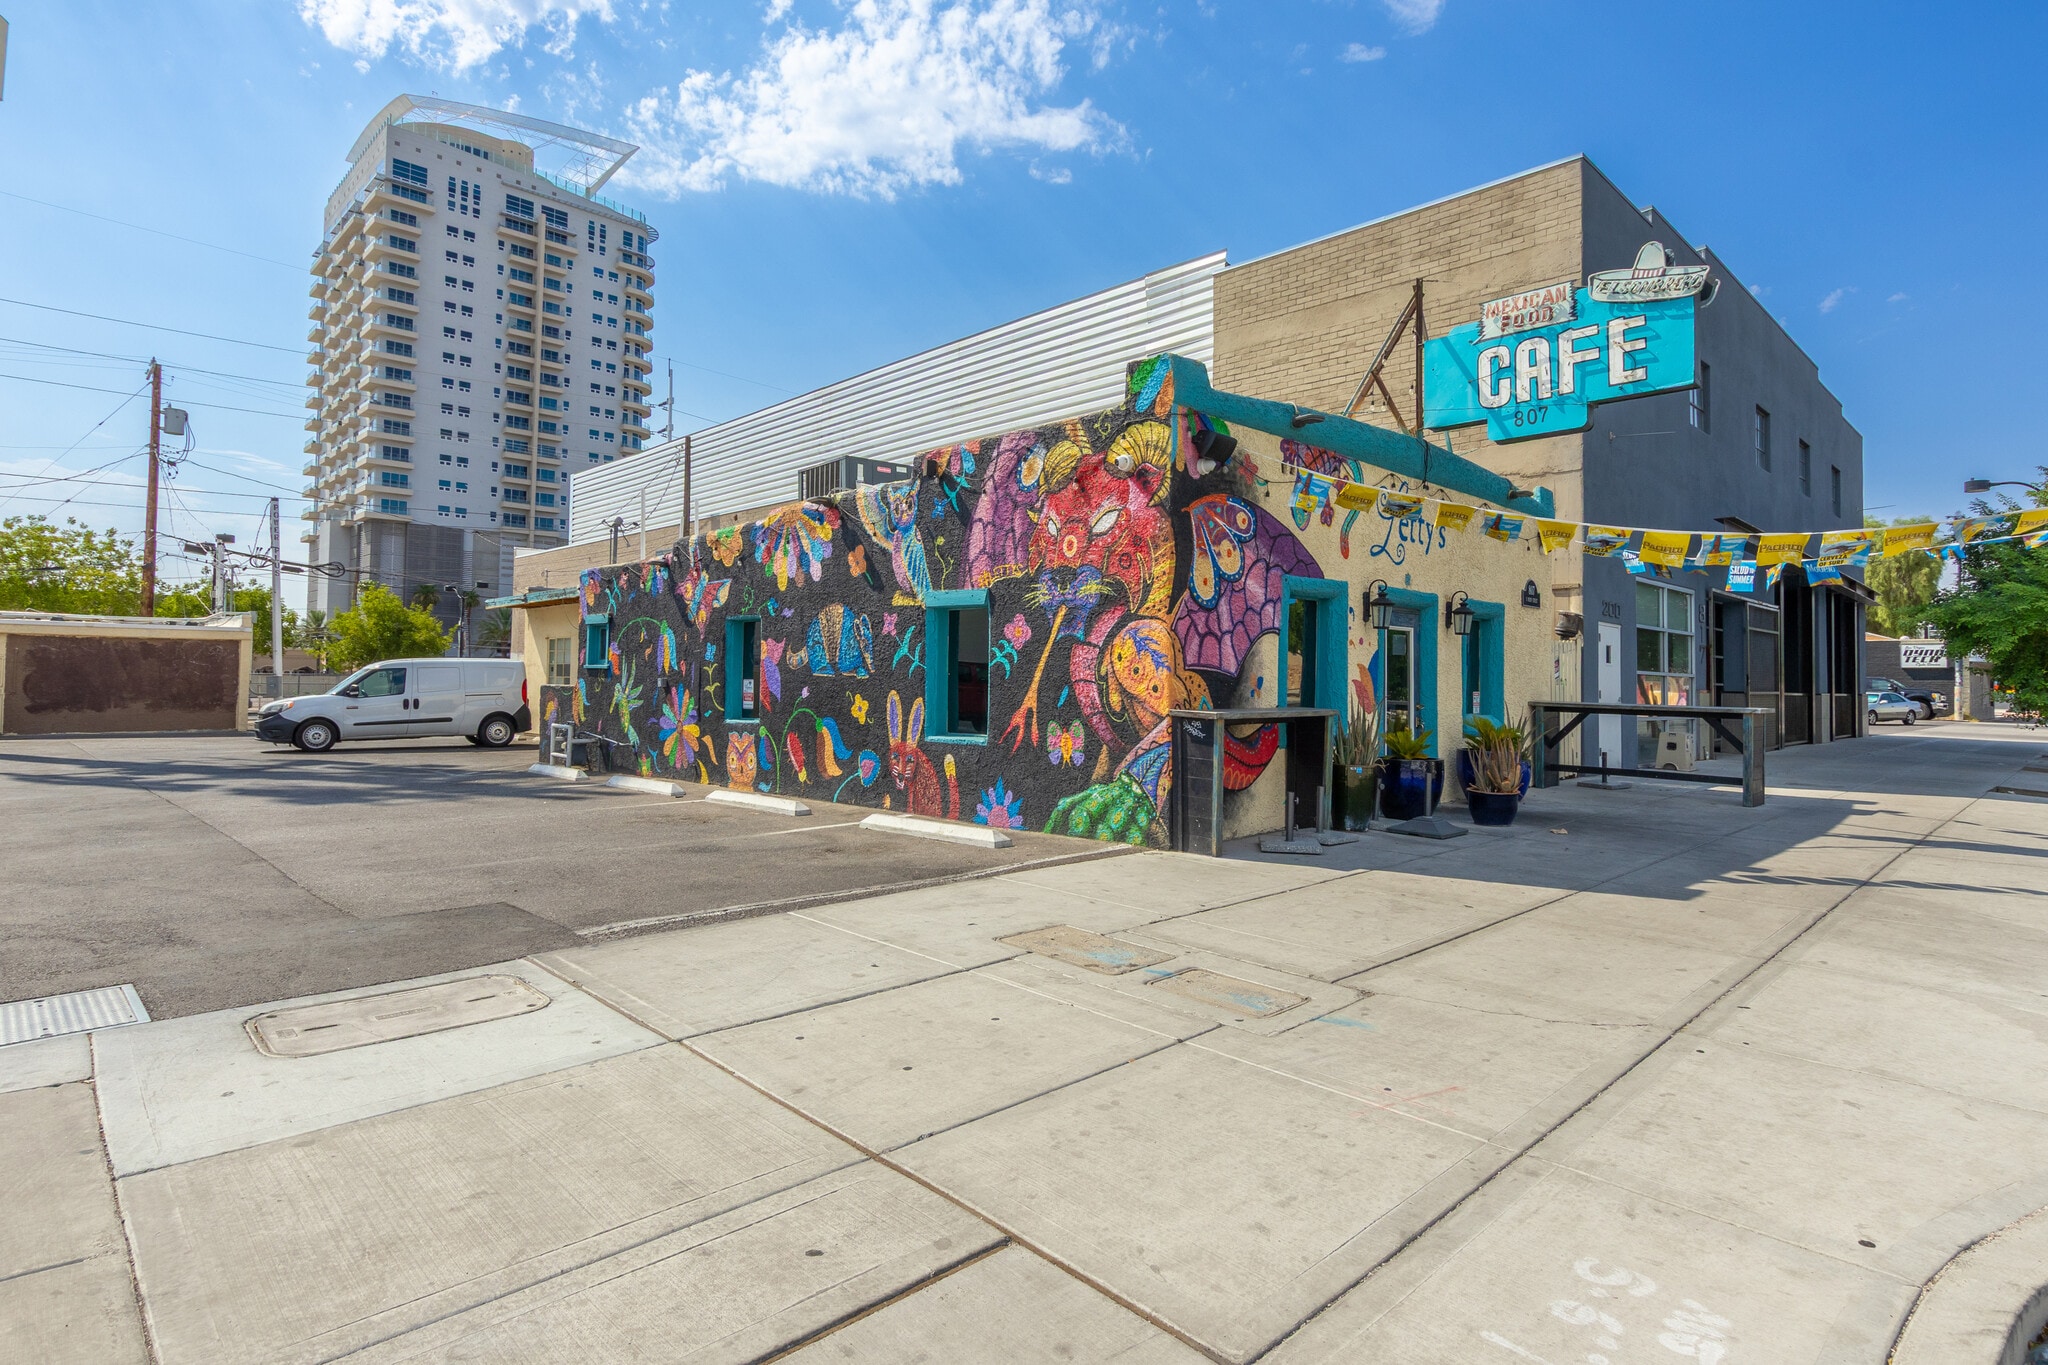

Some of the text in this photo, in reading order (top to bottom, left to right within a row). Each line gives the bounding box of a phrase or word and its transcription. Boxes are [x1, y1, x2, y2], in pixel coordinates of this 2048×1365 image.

[1485, 284, 1569, 318] MEXICAN
[1500, 305, 1554, 332] FOOD
[1477, 315, 1648, 408] CAFE
[1514, 406, 1548, 427] 807
[1370, 481, 1446, 565] Letty's
[1642, 541, 1684, 554] PACIFICO
[1885, 531, 1931, 546] PACIFICO
[1759, 543, 1803, 554] PACIFICO
[1819, 553, 1848, 562] CERVEZA
[1729, 575, 1755, 584] SUMMER
[1730, 565, 1750, 575] SALUD
[1602, 600, 1621, 619] 200
[1698, 604, 1706, 664] 817
